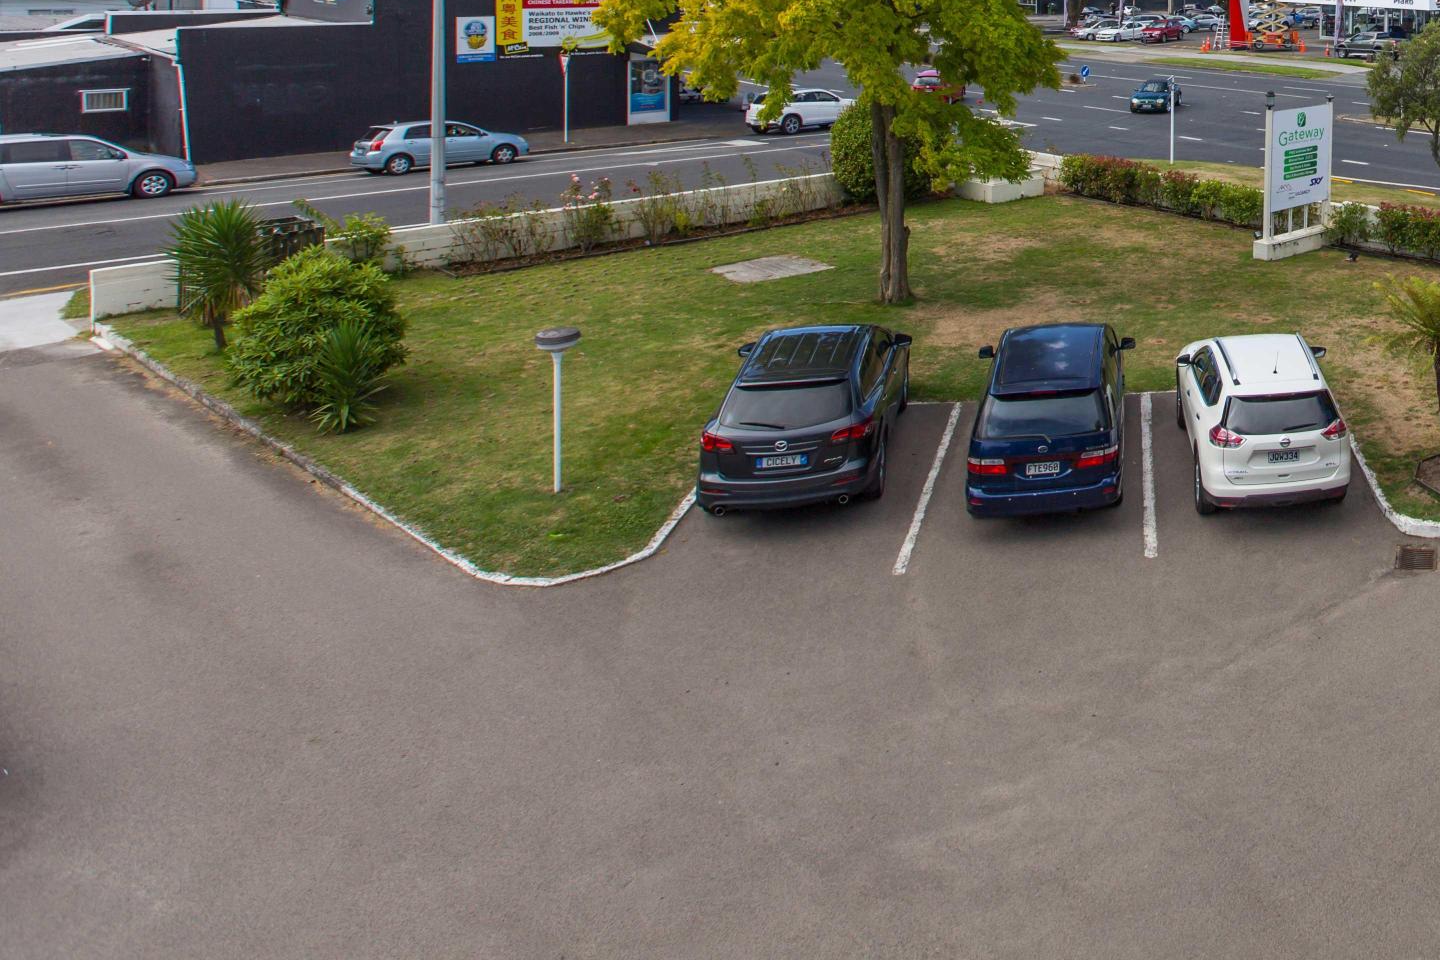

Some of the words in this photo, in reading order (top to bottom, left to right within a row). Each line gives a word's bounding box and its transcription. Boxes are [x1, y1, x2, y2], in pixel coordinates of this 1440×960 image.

[1279, 127, 1325, 147] Gateway
[1309, 176, 1324, 187] SKY
[766, 455, 797, 467] CICELY
